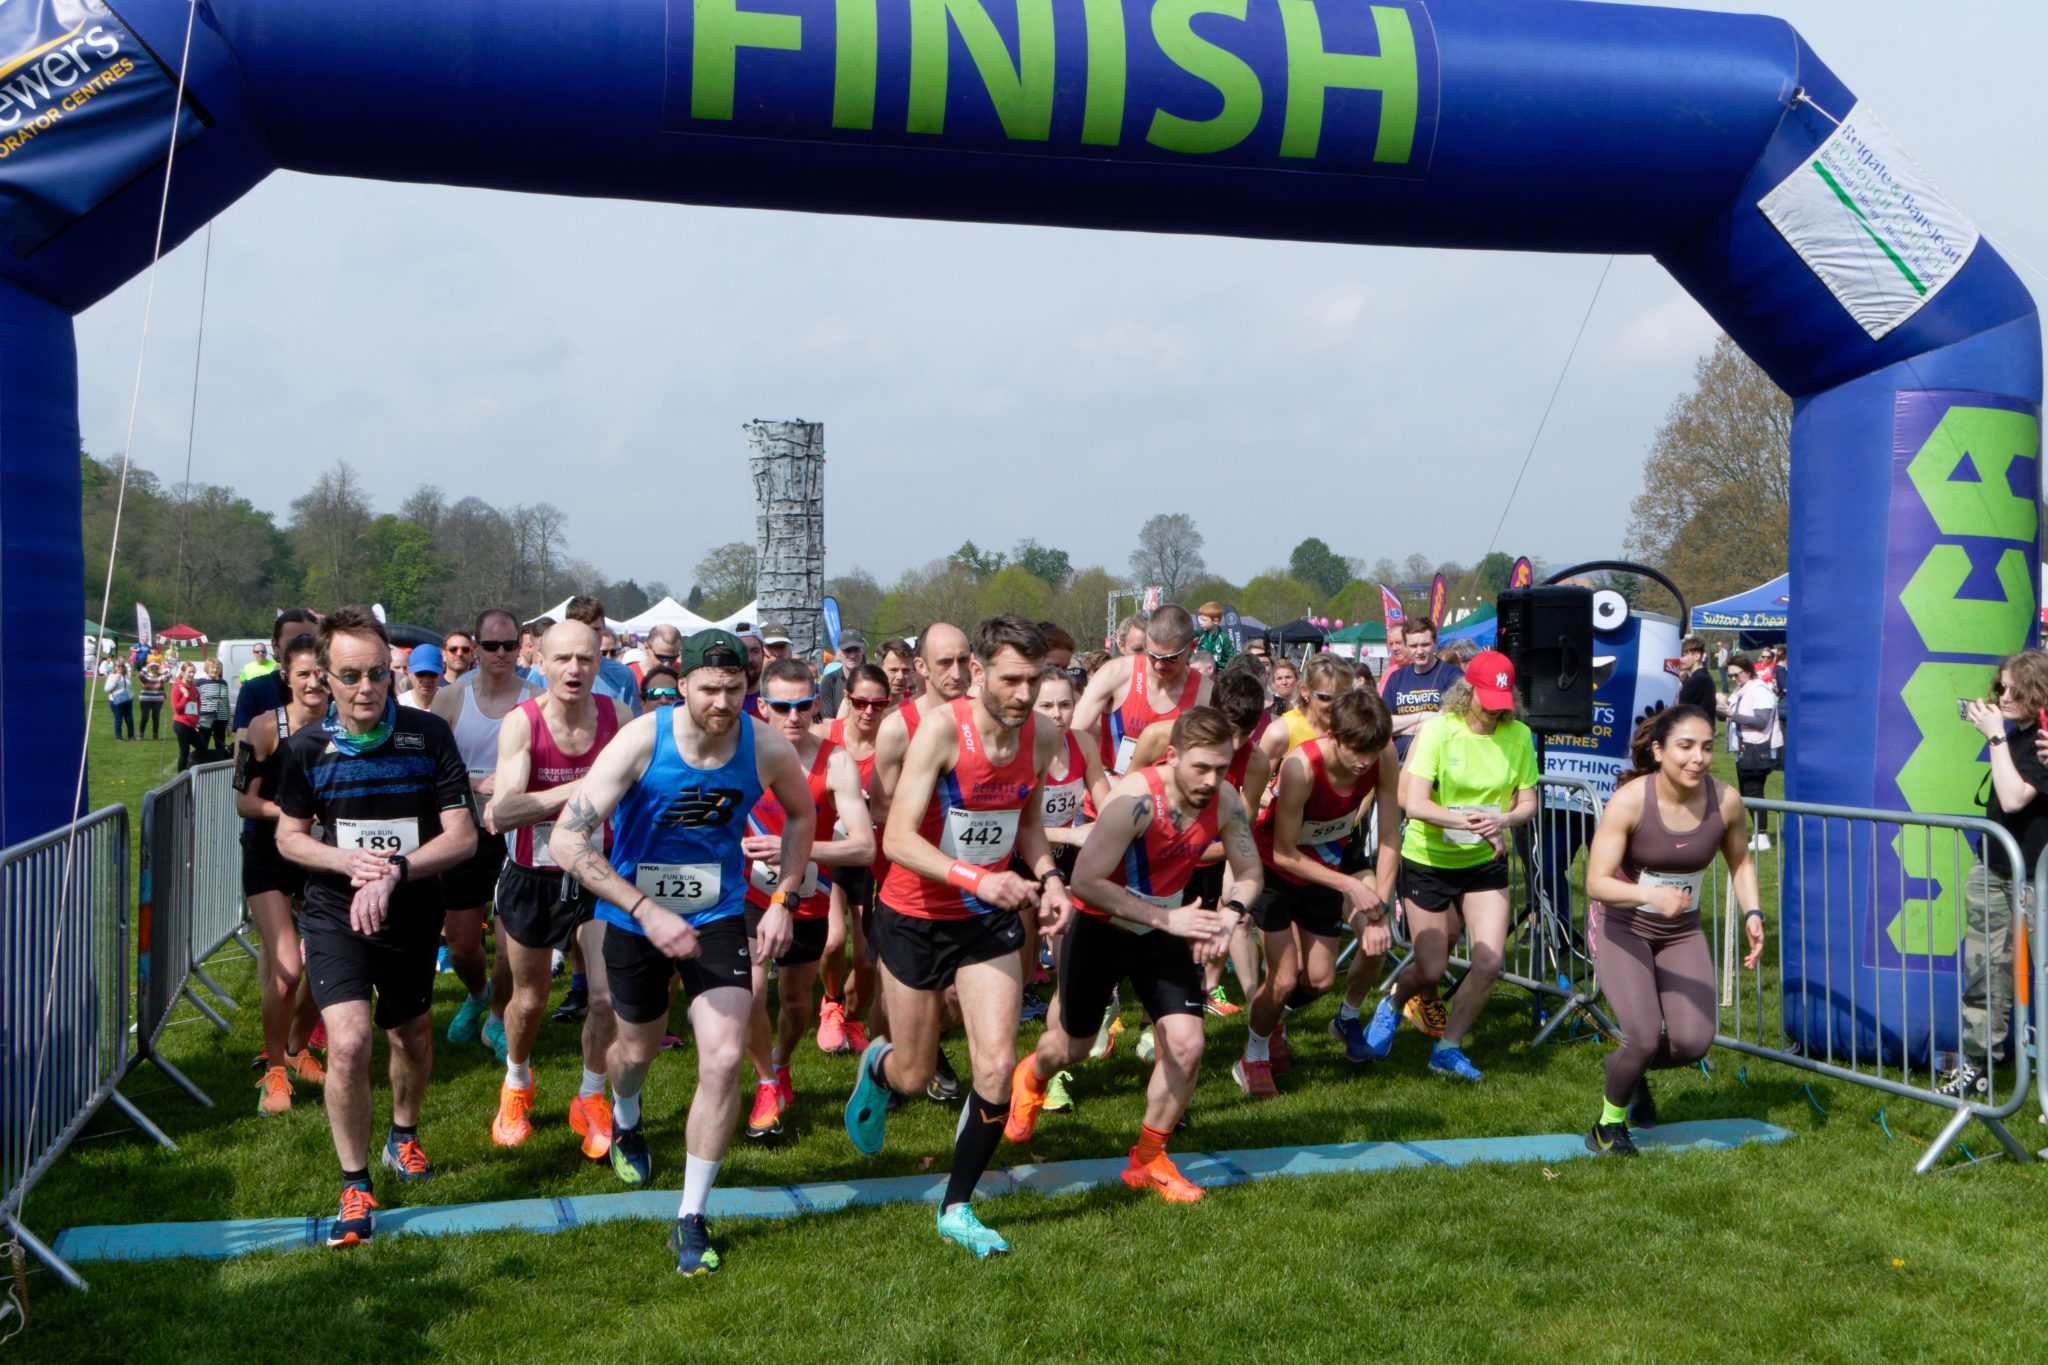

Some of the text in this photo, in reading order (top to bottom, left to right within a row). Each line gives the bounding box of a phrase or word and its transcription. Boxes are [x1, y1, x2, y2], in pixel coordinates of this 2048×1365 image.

[0, 26, 119, 127] ewers
[691, 0, 1419, 164] FINISH
[0, 57, 135, 158] ORATOR CENTRES
[1831, 139, 1892, 210] BOROUGH
[1842, 124, 1892, 184] Reigate
[1901, 194, 1962, 265] Banstead
[1703, 612, 1739, 626] Sutton
[1741, 613, 1751, 626] &
[1886, 406, 2038, 957] YMCA
[1396, 692, 1441, 706] Brewers
[961, 723, 975, 753] soar
[1545, 758, 1622, 776] RYTHING
[950, 810, 969, 818] YMCA
[1046, 795, 1076, 814] 634
[970, 820, 984, 828] FUN
[355, 836, 402, 851] 189
[959, 826, 1003, 846] 442
[654, 880, 703, 899] 123
